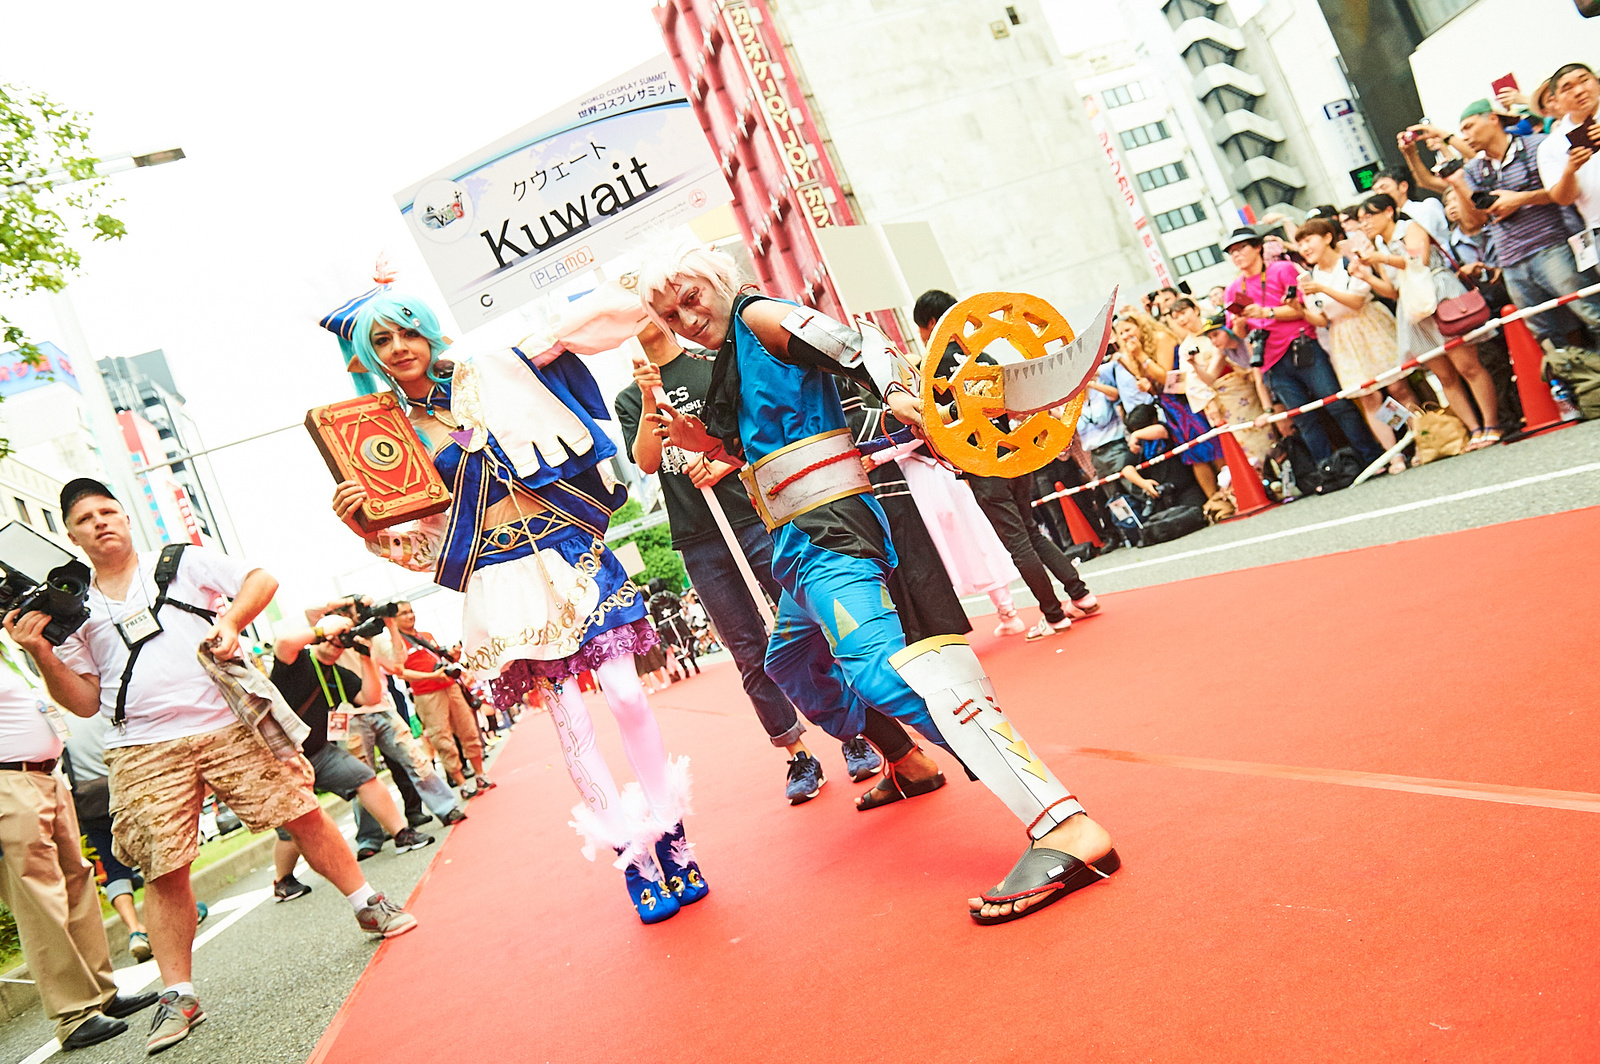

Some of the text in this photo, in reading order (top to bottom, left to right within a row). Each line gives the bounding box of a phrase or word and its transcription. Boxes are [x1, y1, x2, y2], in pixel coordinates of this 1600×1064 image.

[578, 80, 677, 118] 世界コスプレサミット
[581, 71, 668, 106] WORLD COSPLAY SUMMIT
[513, 141, 606, 201] クウェート
[480, 156, 658, 268] Kuwait
[804, 187, 836, 229] カラ
[125, 614, 147, 628] PRESS
